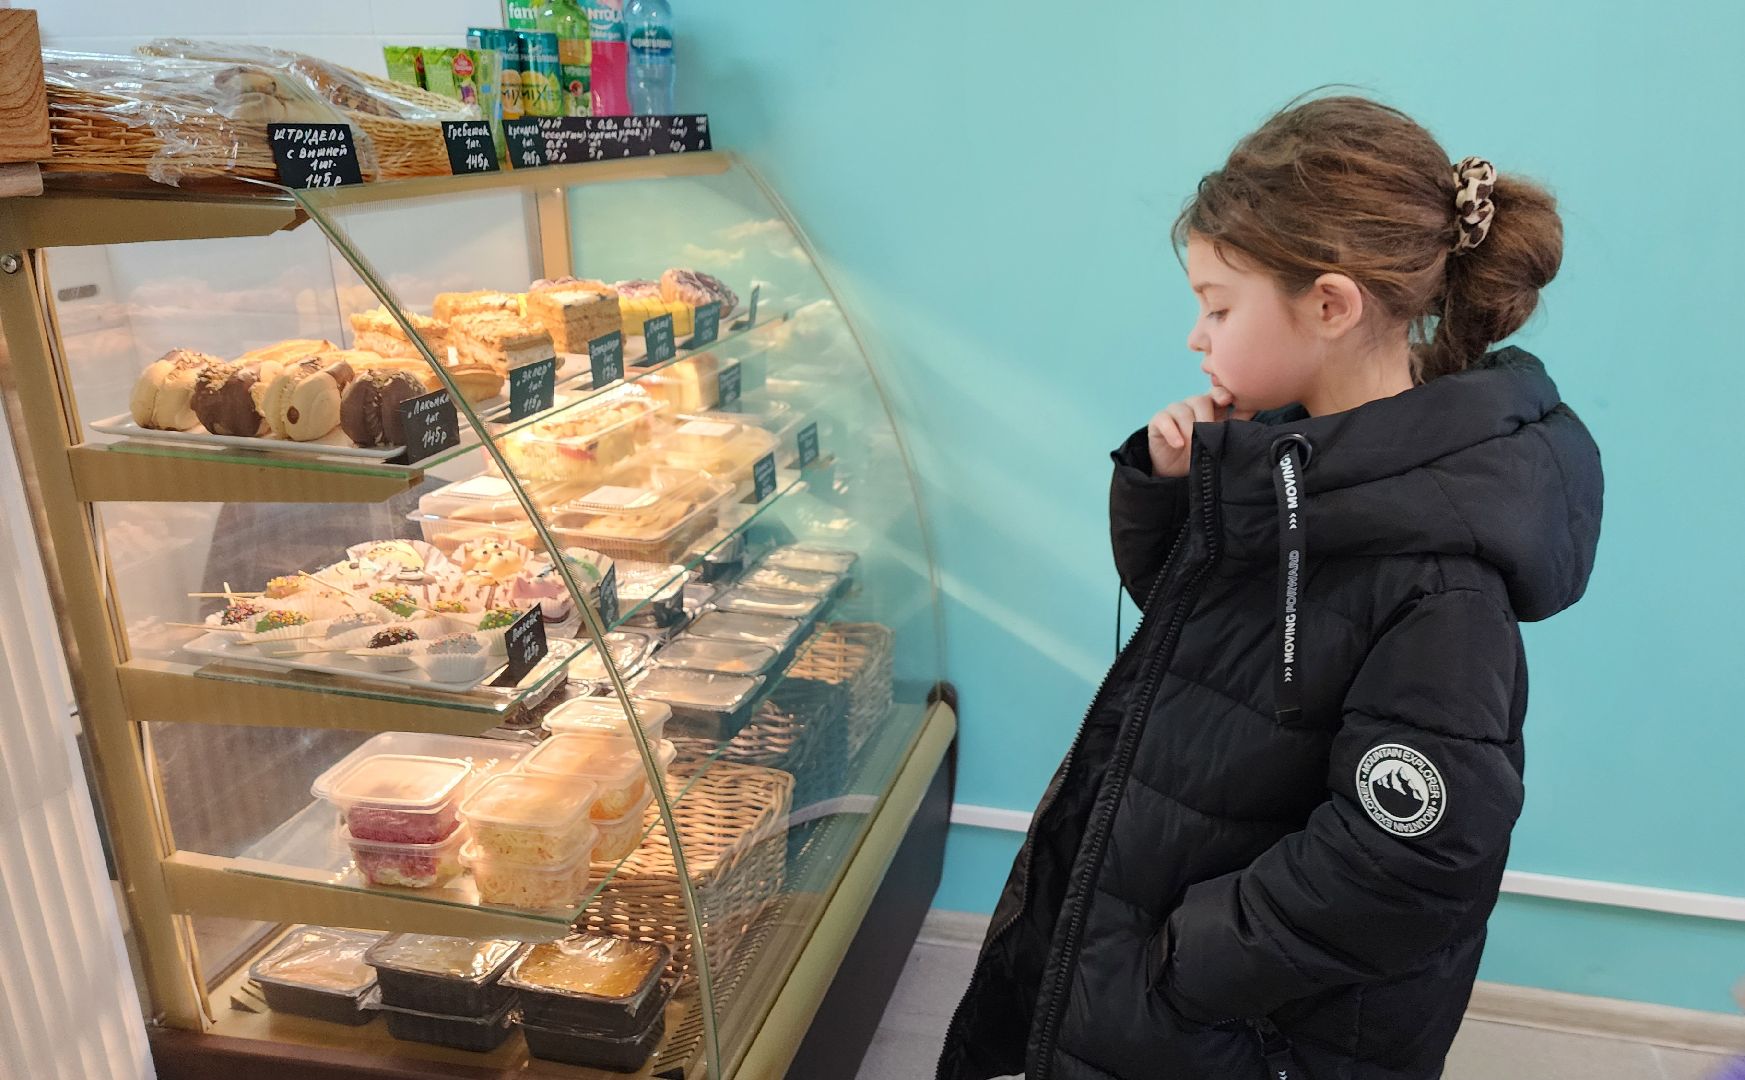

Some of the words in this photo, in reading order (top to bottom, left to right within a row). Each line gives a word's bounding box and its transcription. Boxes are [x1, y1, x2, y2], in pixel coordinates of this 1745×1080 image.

[1280, 457, 1299, 509] MOVING
[1286, 550, 1300, 612] FORWARD
[1284, 613, 1297, 664] MOVING
[1361, 748, 1402, 774] MOUNTAIN
[1402, 750, 1441, 799] EXPLORER
[1360, 780, 1394, 828] EXPLORER
[1393, 805, 1438, 833] MOUNTAIN
